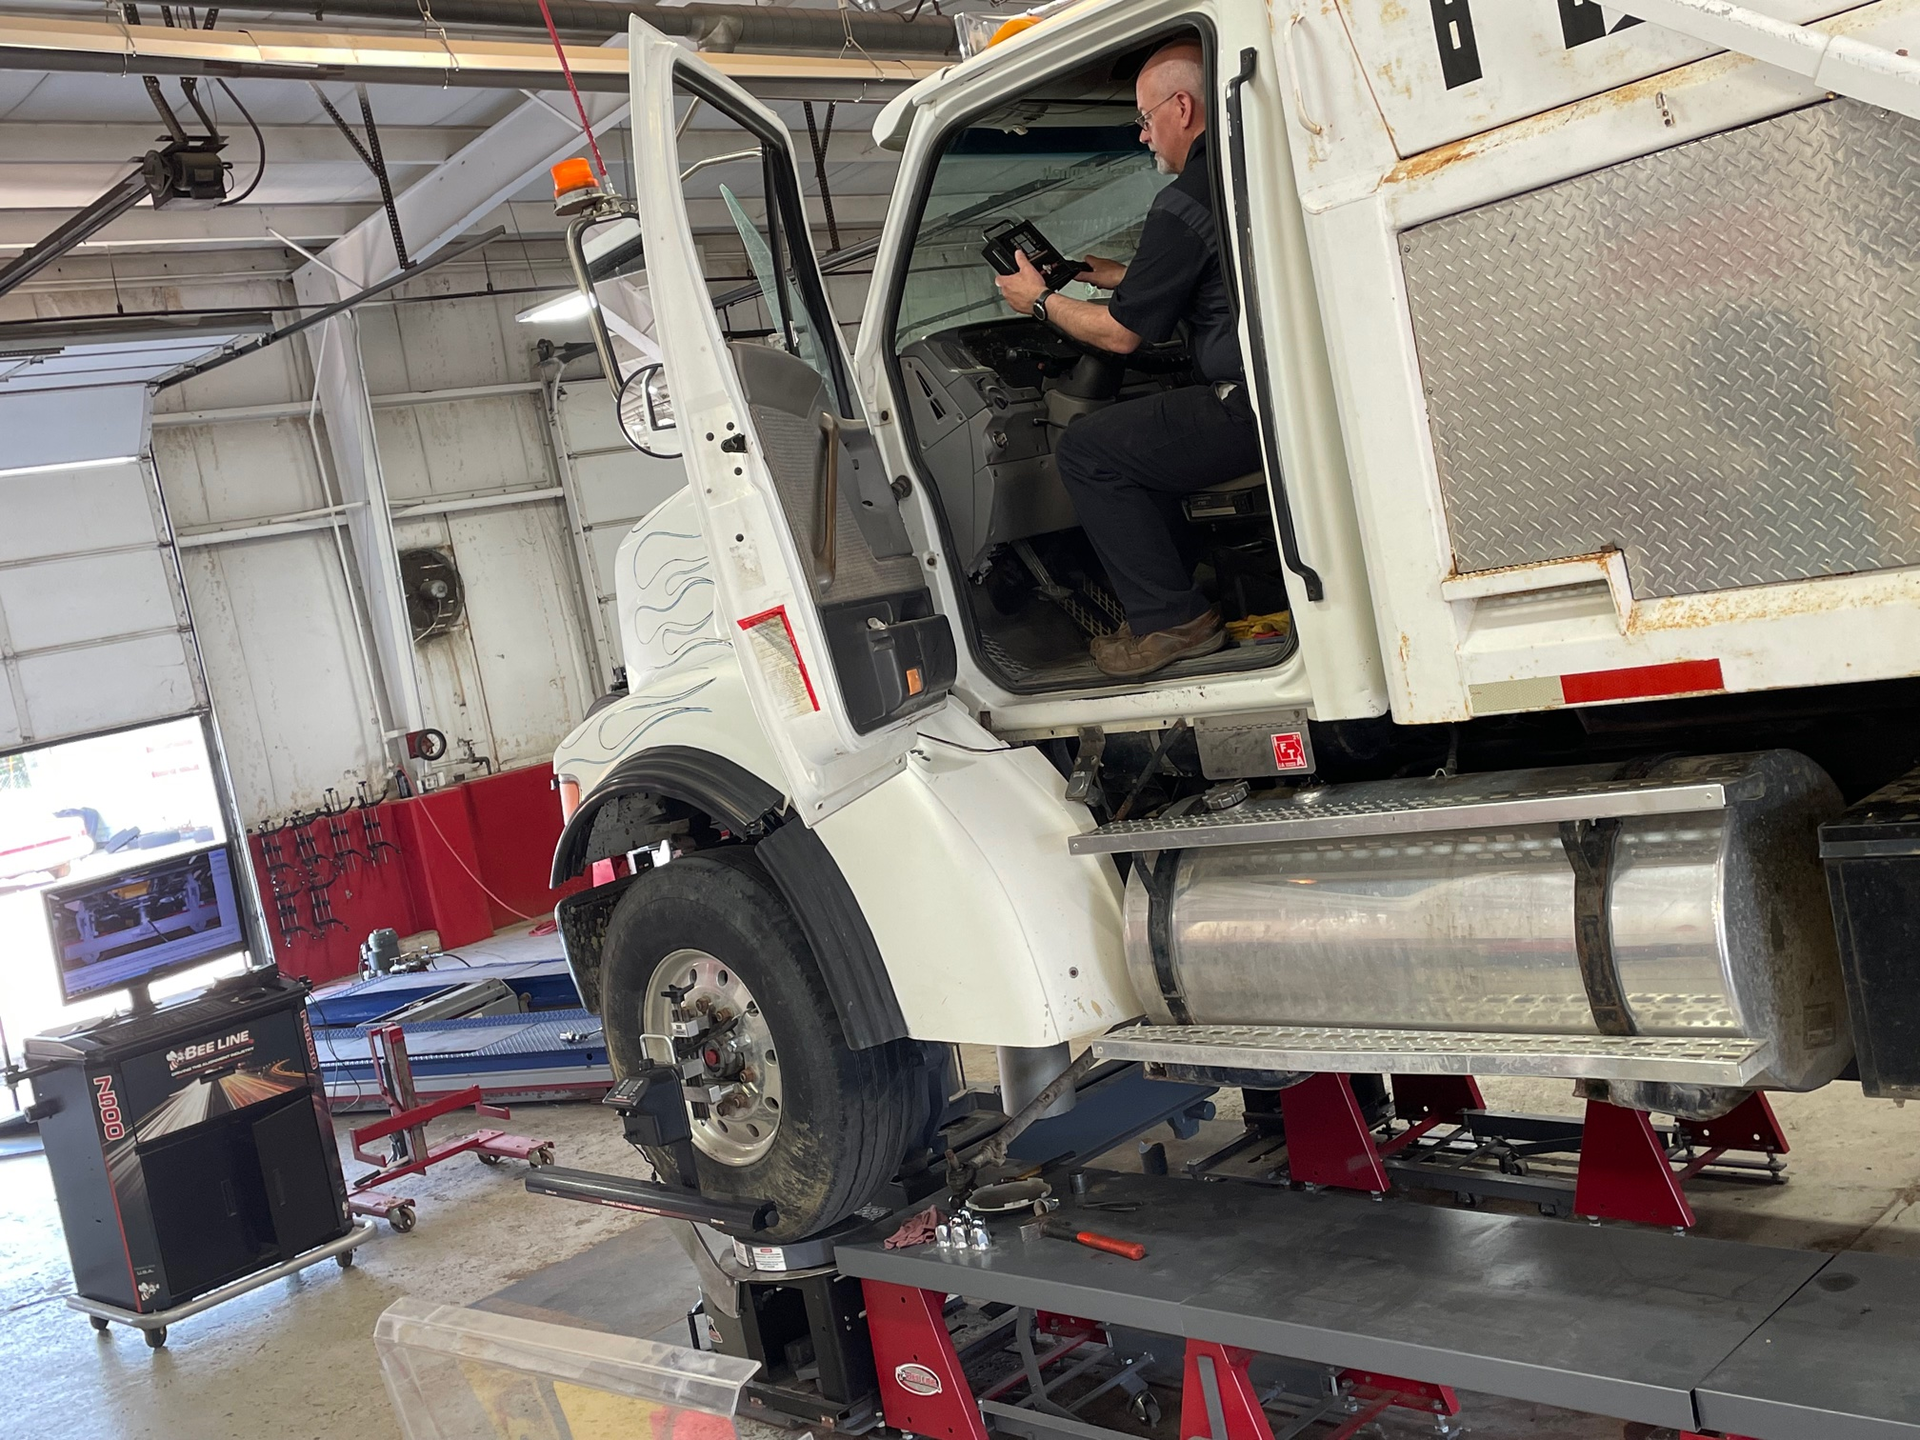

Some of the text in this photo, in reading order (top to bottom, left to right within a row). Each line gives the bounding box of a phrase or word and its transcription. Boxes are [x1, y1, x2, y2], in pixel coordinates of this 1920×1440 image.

[185, 1030, 249, 1060] BEE LINE
[93, 1075, 125, 1141] 7500
